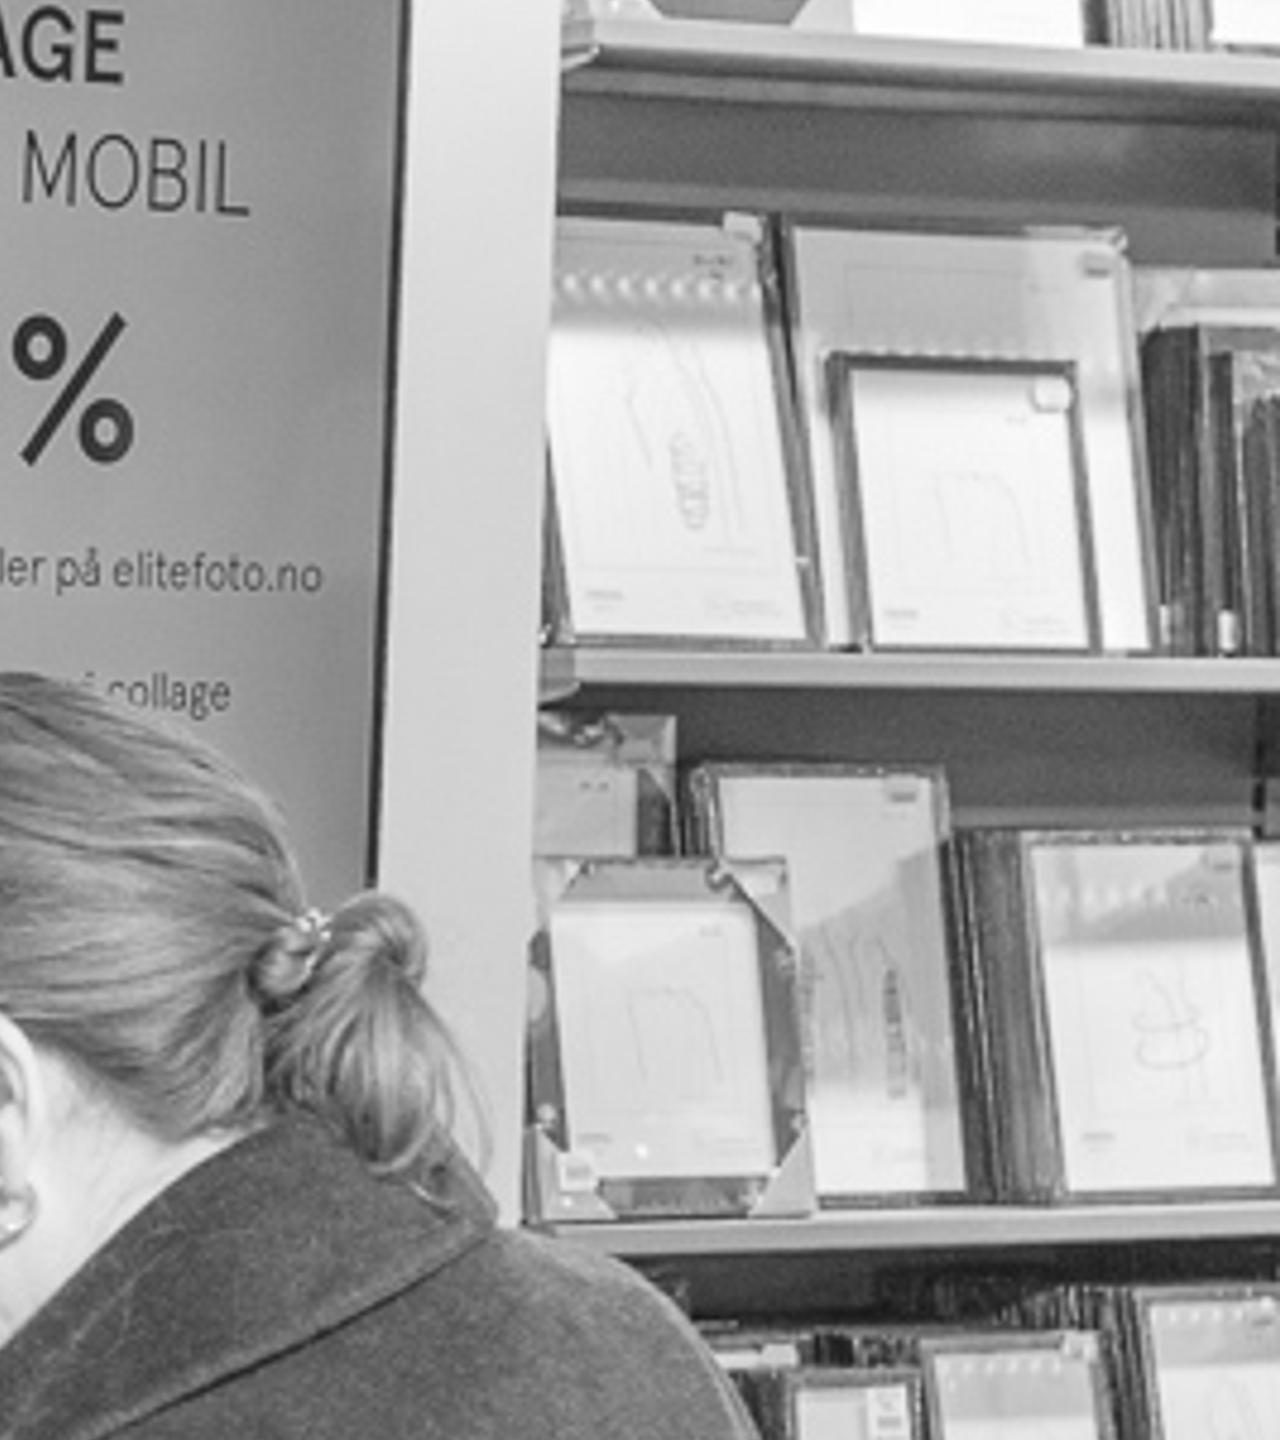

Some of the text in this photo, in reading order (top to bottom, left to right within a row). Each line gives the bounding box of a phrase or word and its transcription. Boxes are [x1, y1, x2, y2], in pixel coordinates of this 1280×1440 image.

[22, 129, 251, 218] MOBIL
[55, 546, 101, 597] på
[112, 550, 327, 597] elitefoto.no
